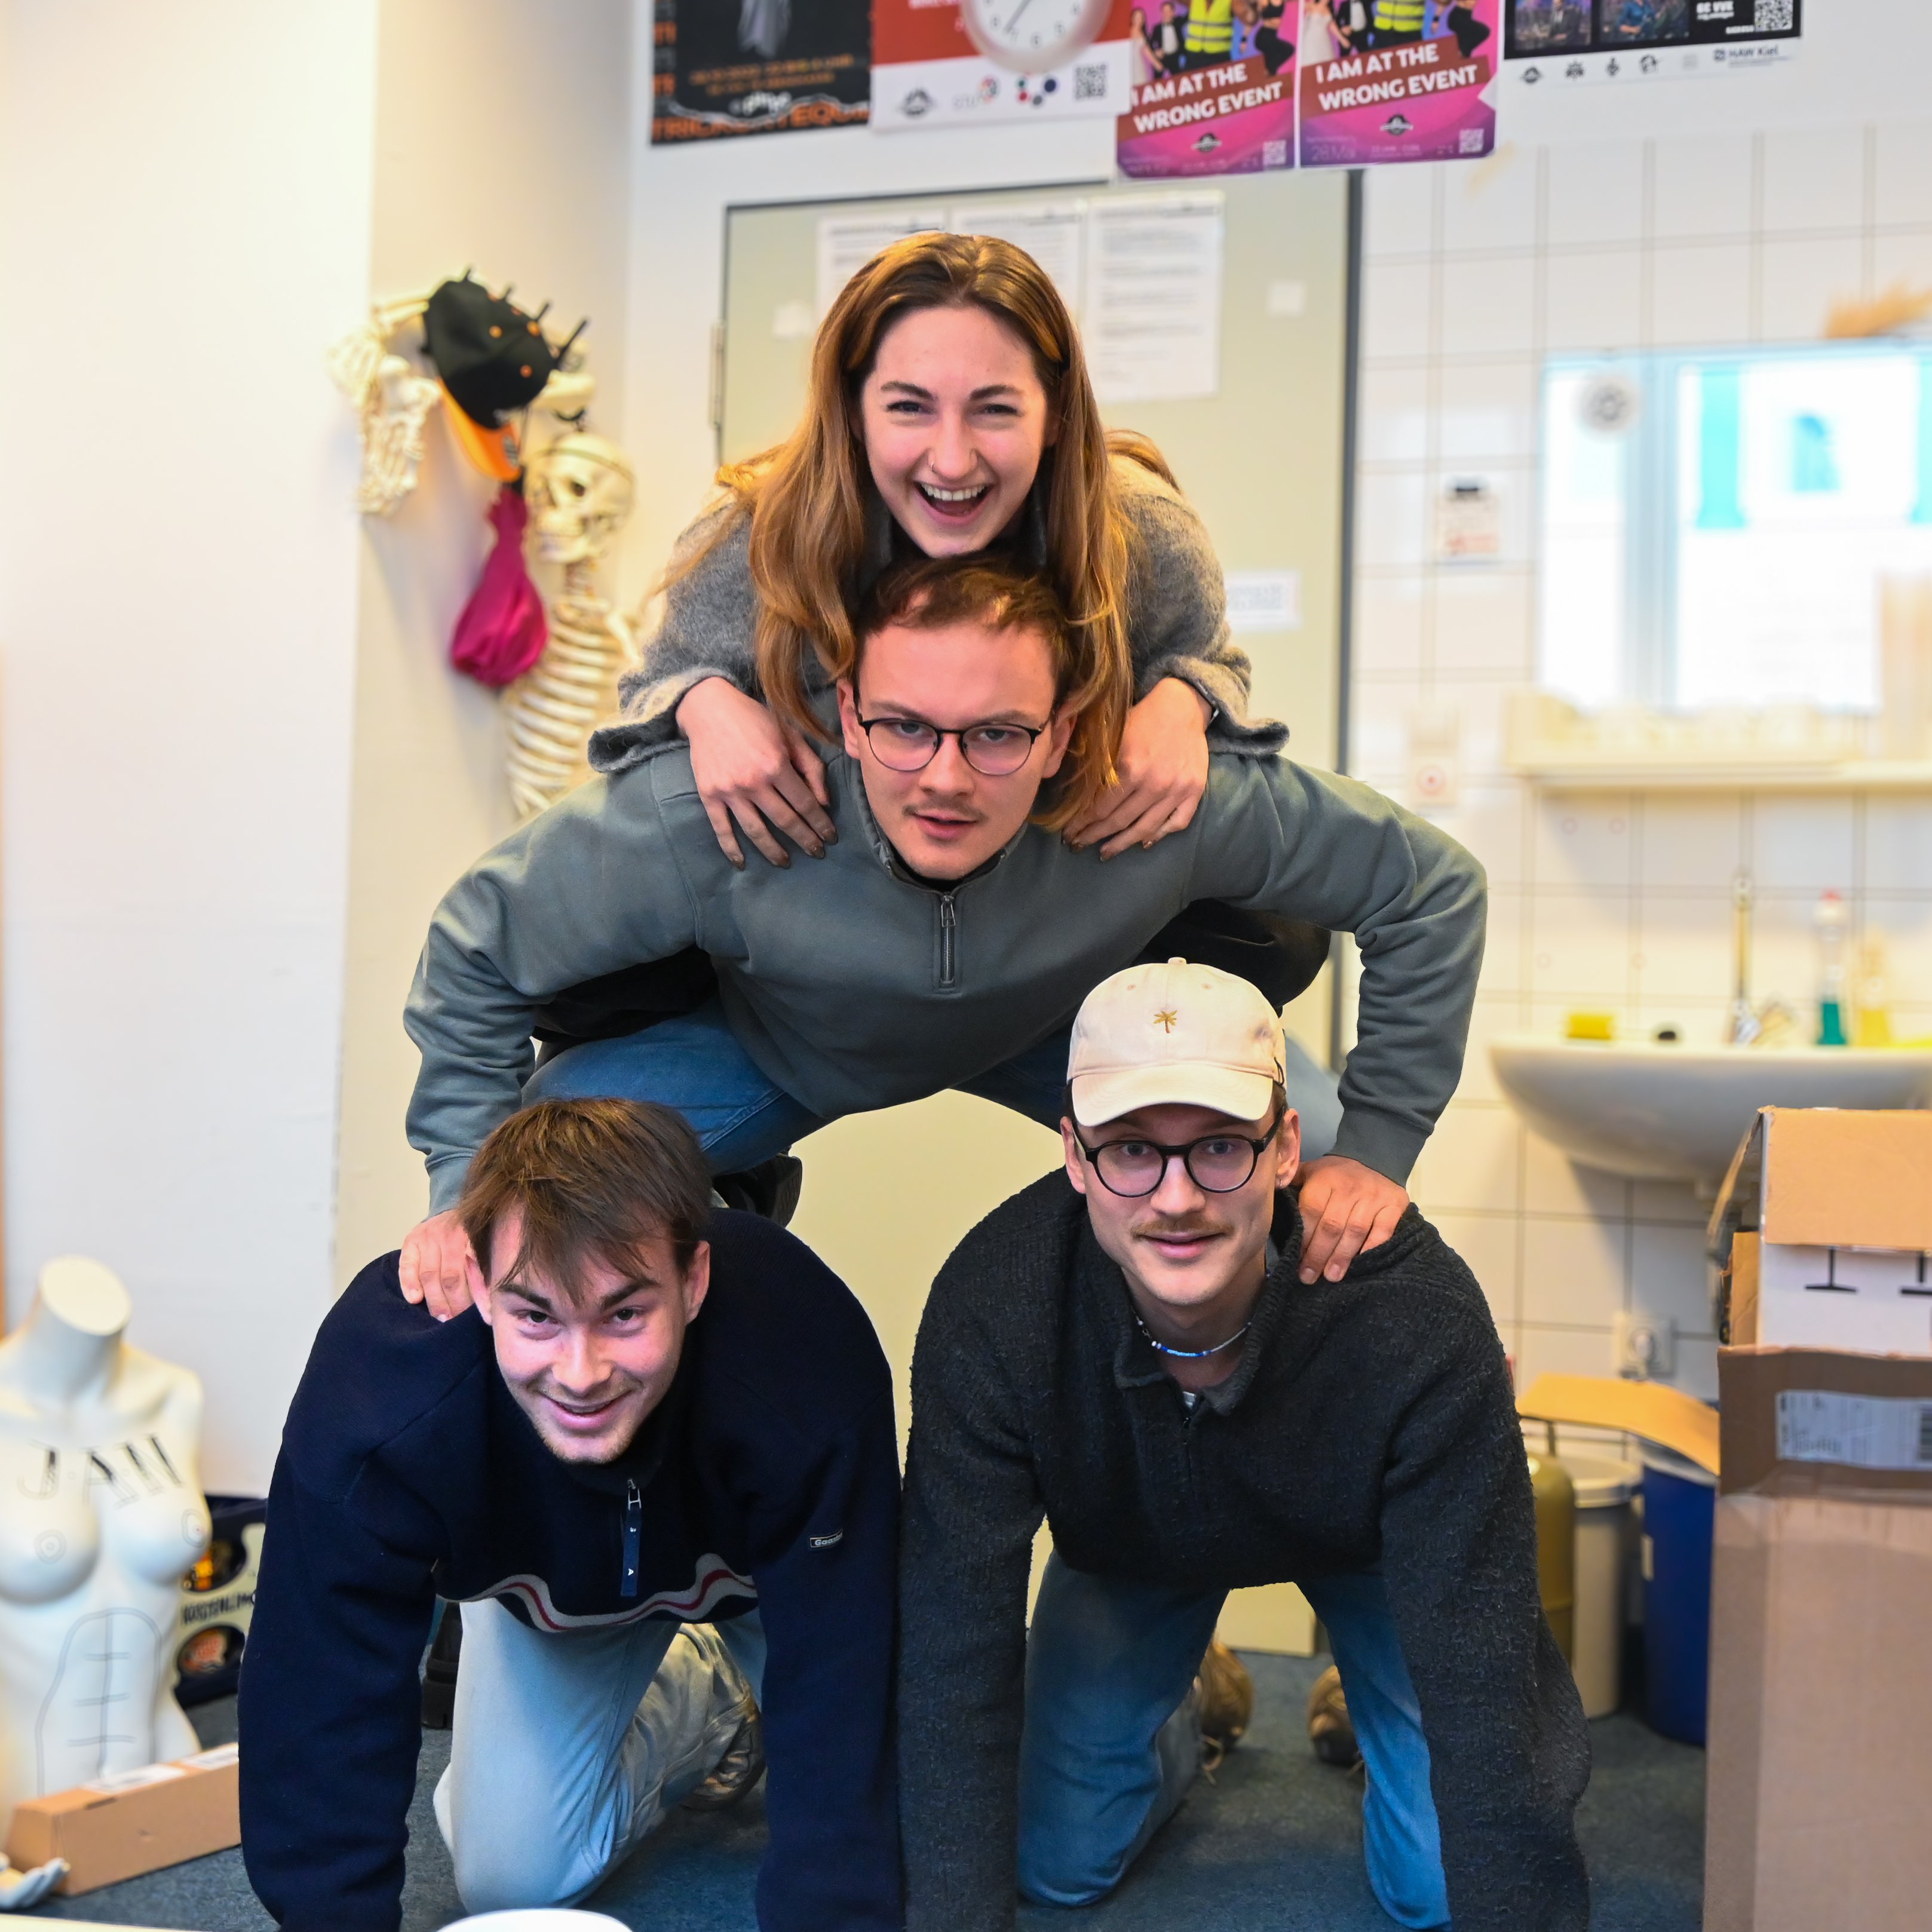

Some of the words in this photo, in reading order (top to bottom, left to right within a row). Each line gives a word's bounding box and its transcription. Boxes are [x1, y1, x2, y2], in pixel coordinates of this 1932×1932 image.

[1131, 87, 1139, 107] I
[1141, 79, 1176, 105] AM
[1178, 72, 1204, 96] AT
[1206, 63, 1248, 88] THE
[1315, 65, 1324, 83] I
[1327, 58, 1363, 82] AM
[1366, 51, 1393, 75] AT
[1395, 42, 1440, 68] THE
[1133, 99, 1217, 133] WRONG
[1218, 81, 1283, 114] EVENT
[1318, 78, 1405, 111] WRONG
[1407, 64, 1478, 95] EVENT
